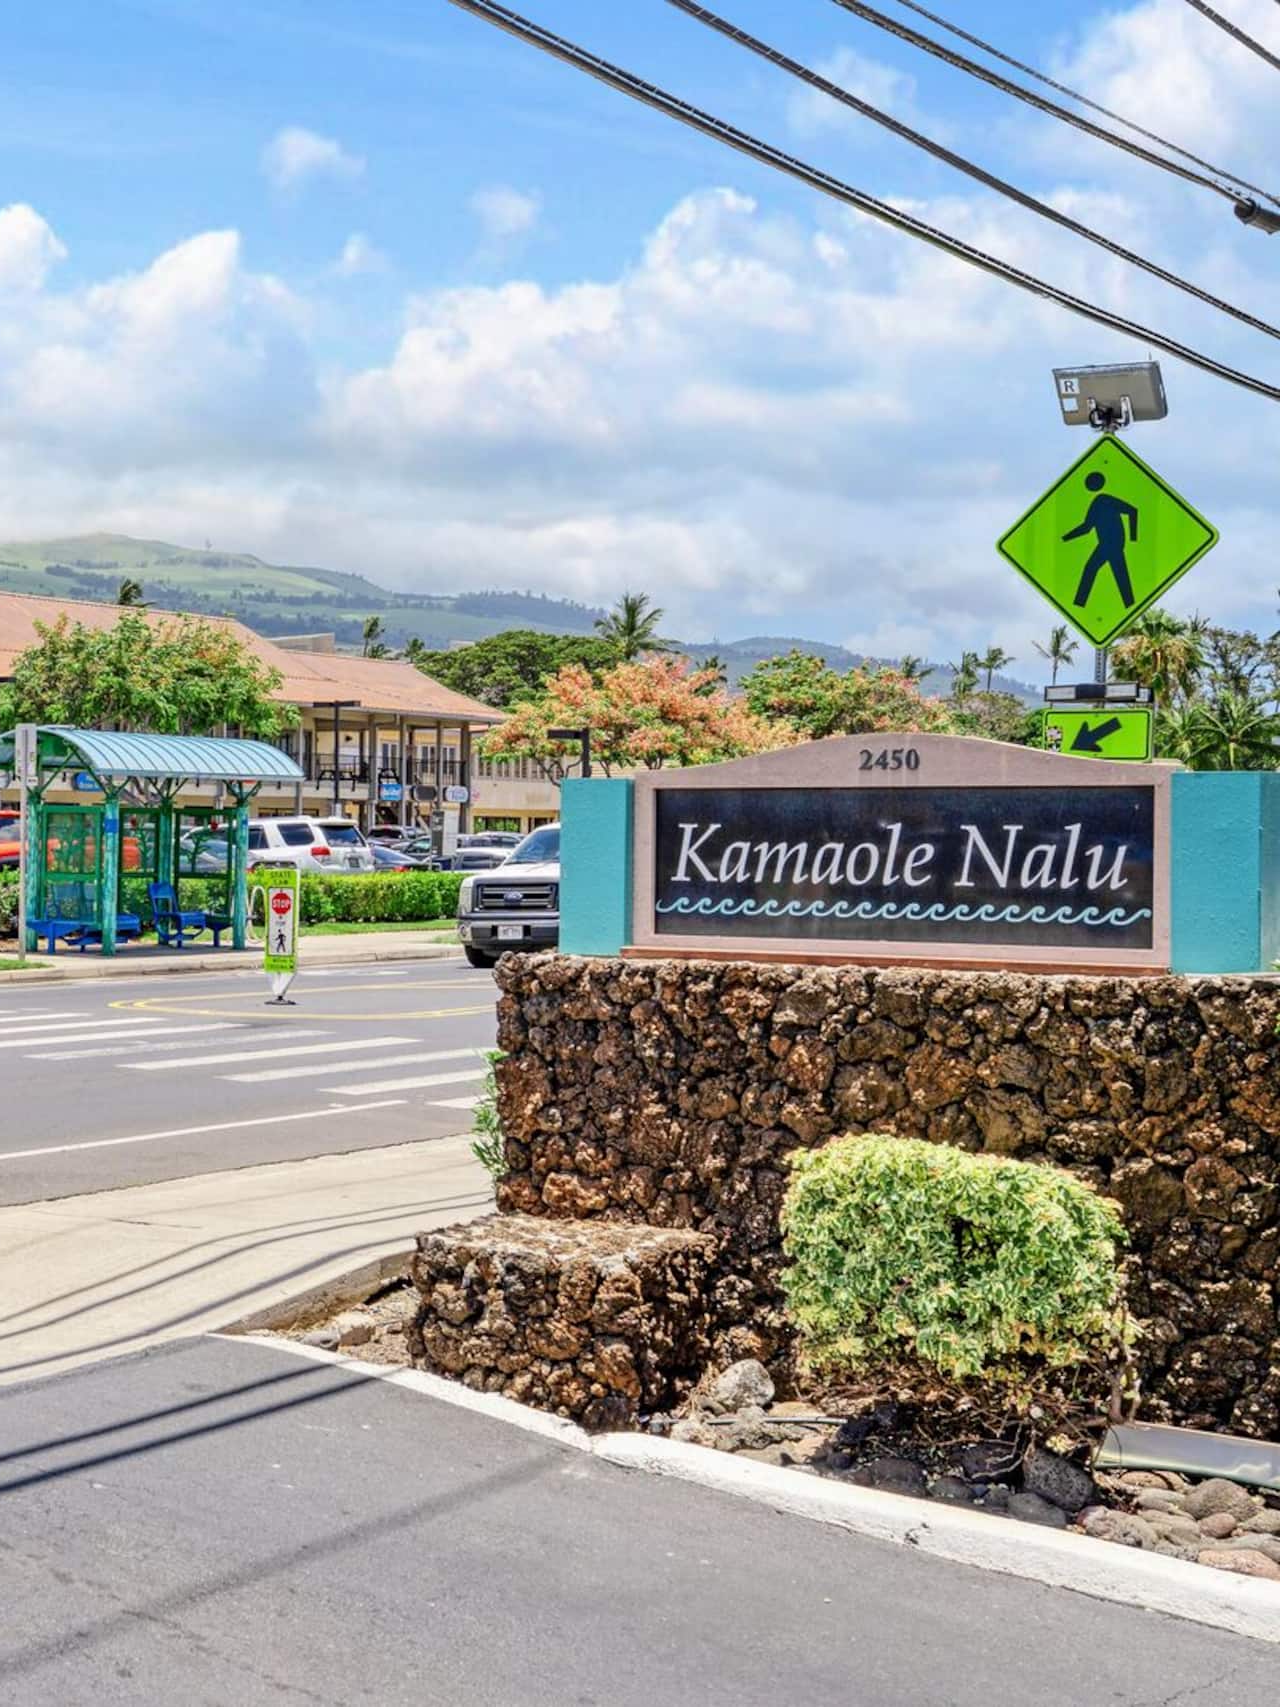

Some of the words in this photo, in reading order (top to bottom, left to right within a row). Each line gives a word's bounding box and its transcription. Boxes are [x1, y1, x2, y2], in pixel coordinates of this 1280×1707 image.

[1064, 380, 1075, 393] R
[858, 749, 920, 771] 2450
[670, 822, 935, 887] Kamaole
[954, 822, 1129, 891] Nalu
[272, 899, 290, 908] STOP
